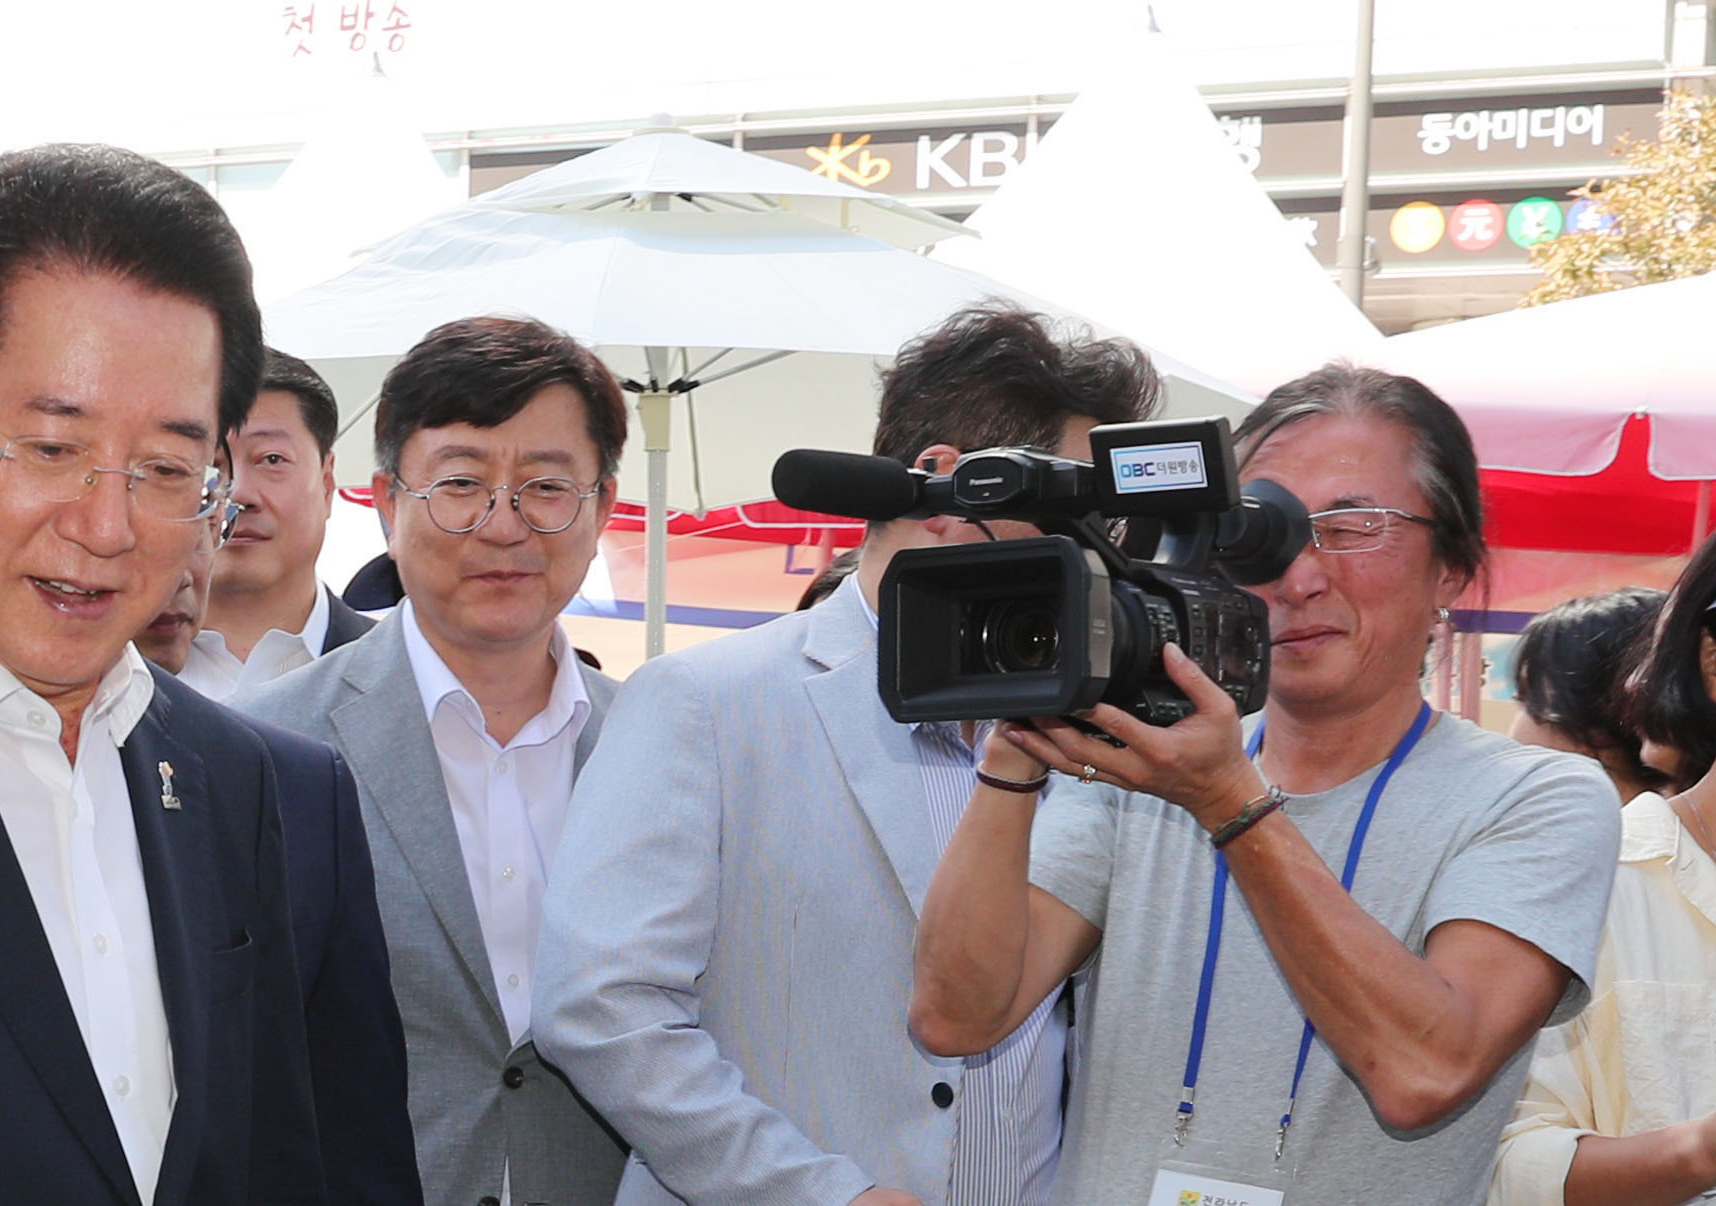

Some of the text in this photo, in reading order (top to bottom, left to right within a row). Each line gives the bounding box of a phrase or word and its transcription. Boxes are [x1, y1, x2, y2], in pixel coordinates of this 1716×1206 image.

[282, 0, 411, 57] 첫 방송
[1417, 104, 1604, 156] 동아미디어
[1156, 458, 1199, 476] 더원방송
